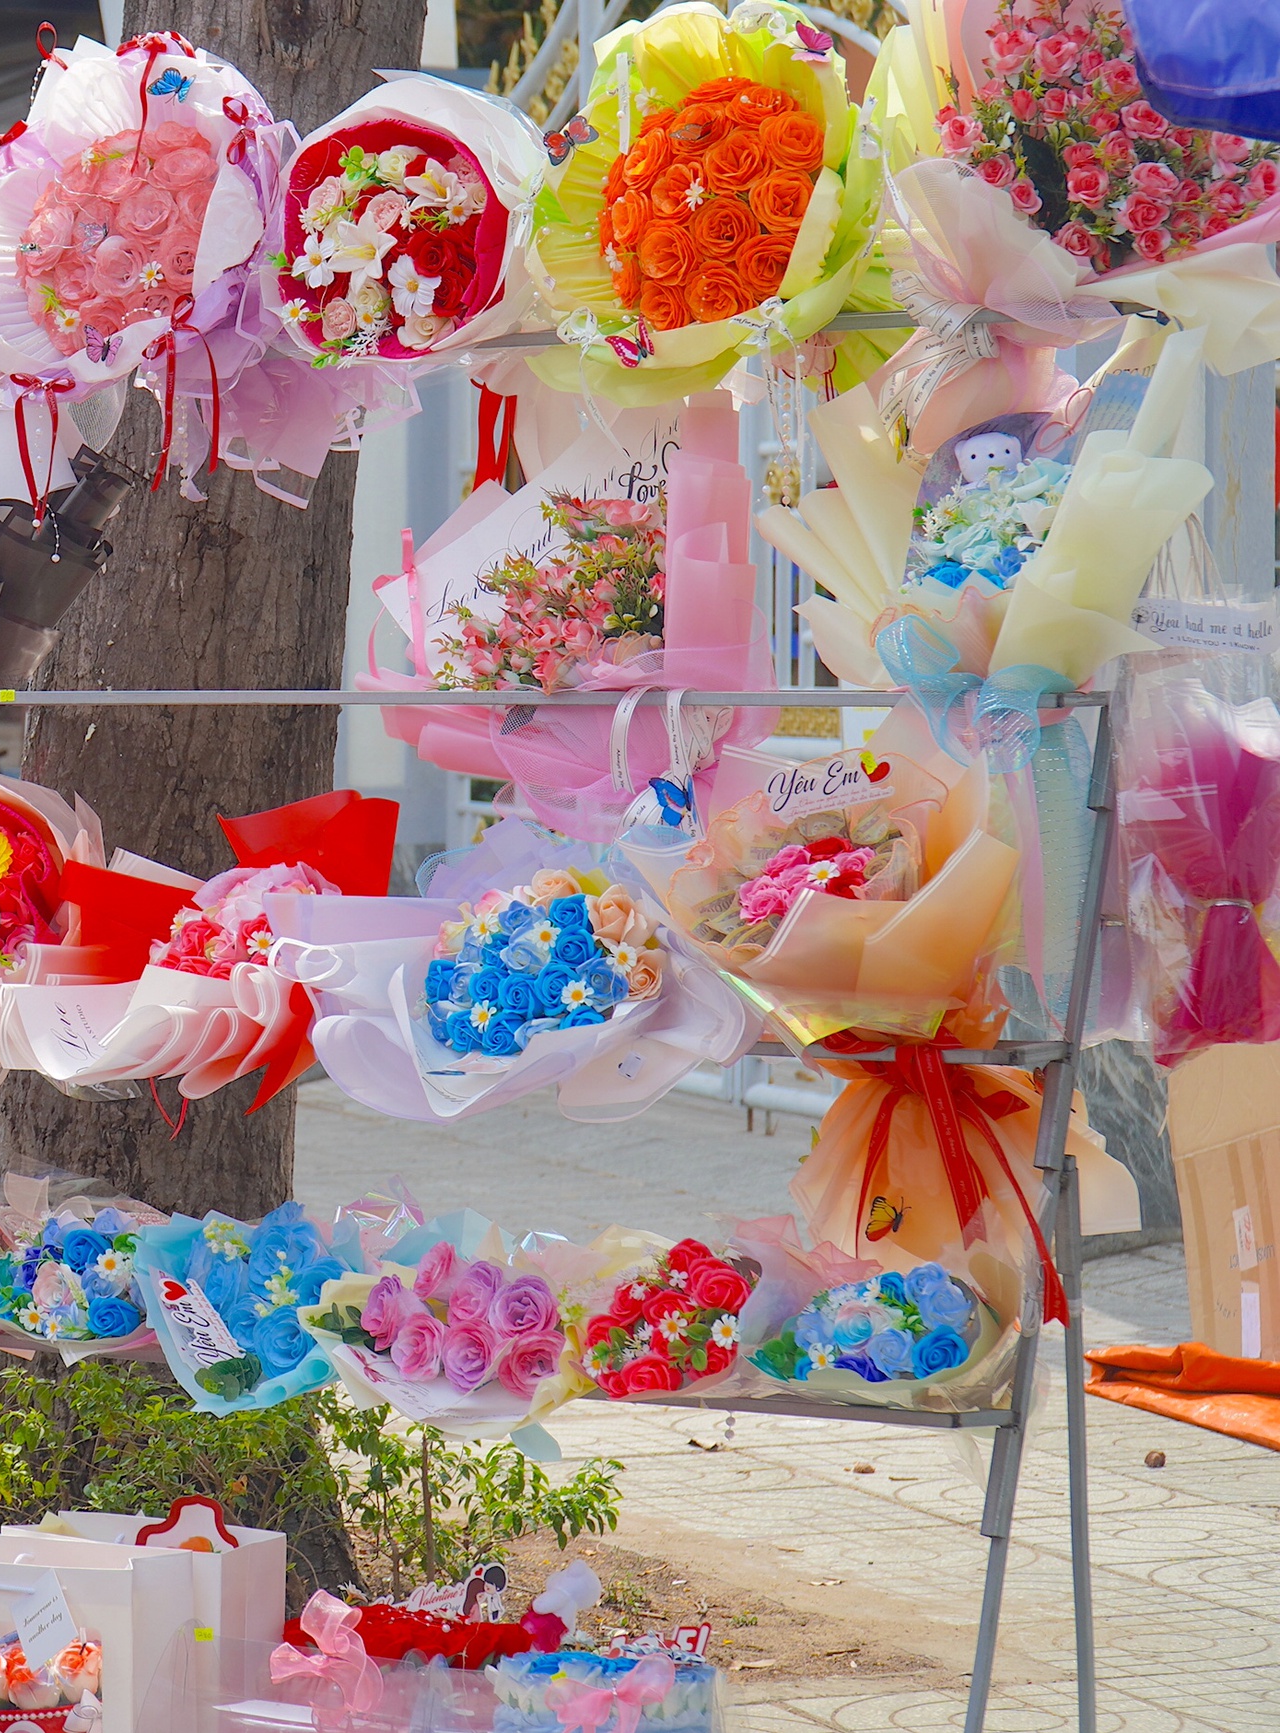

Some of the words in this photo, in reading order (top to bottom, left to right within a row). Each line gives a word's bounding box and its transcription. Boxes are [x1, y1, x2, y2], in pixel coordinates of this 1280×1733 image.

[167, 371, 175, 395] CHANEL
[1149, 610, 1180, 634] You
[1185, 615, 1204, 633] had
[1210, 623, 1227, 635] me
[1248, 620, 1273, 639] hello
[767, 768, 818, 813] Yêu
[822, 760, 862, 796] Em
[75, 1003, 95, 1036] STUDIO
[948, 1137, 957, 1158] Always
[173, 1300, 210, 1328] Em
[412, 1584, 465, 1608] Valentine's
[28, 1621, 50, 1643] another
[50, 1612, 63, 1625] day
